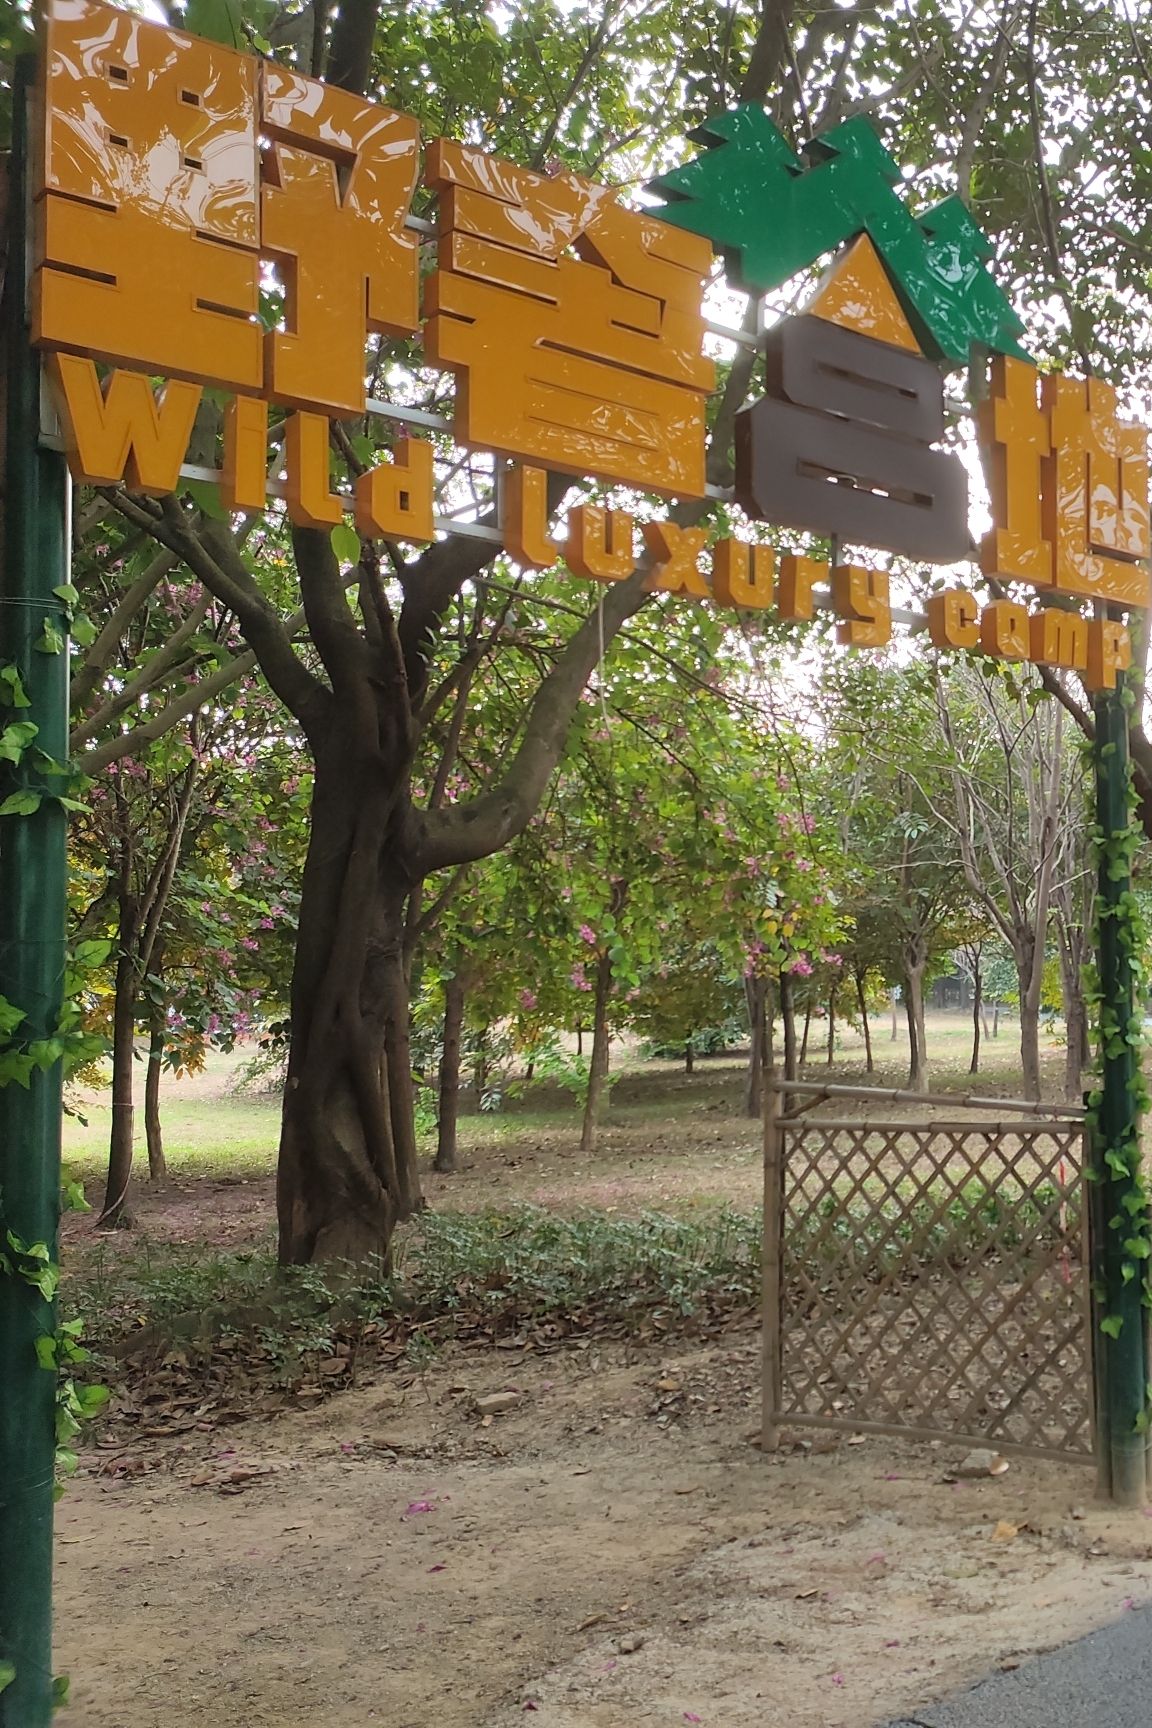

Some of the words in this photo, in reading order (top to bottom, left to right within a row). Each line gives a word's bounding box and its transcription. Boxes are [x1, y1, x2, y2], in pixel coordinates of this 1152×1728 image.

[38, 2, 1152, 608] 野奢营地
[57, 351, 433, 541] Wild
[506, 465, 892, 648] luxury
[928, 589, 1132, 690] camp
